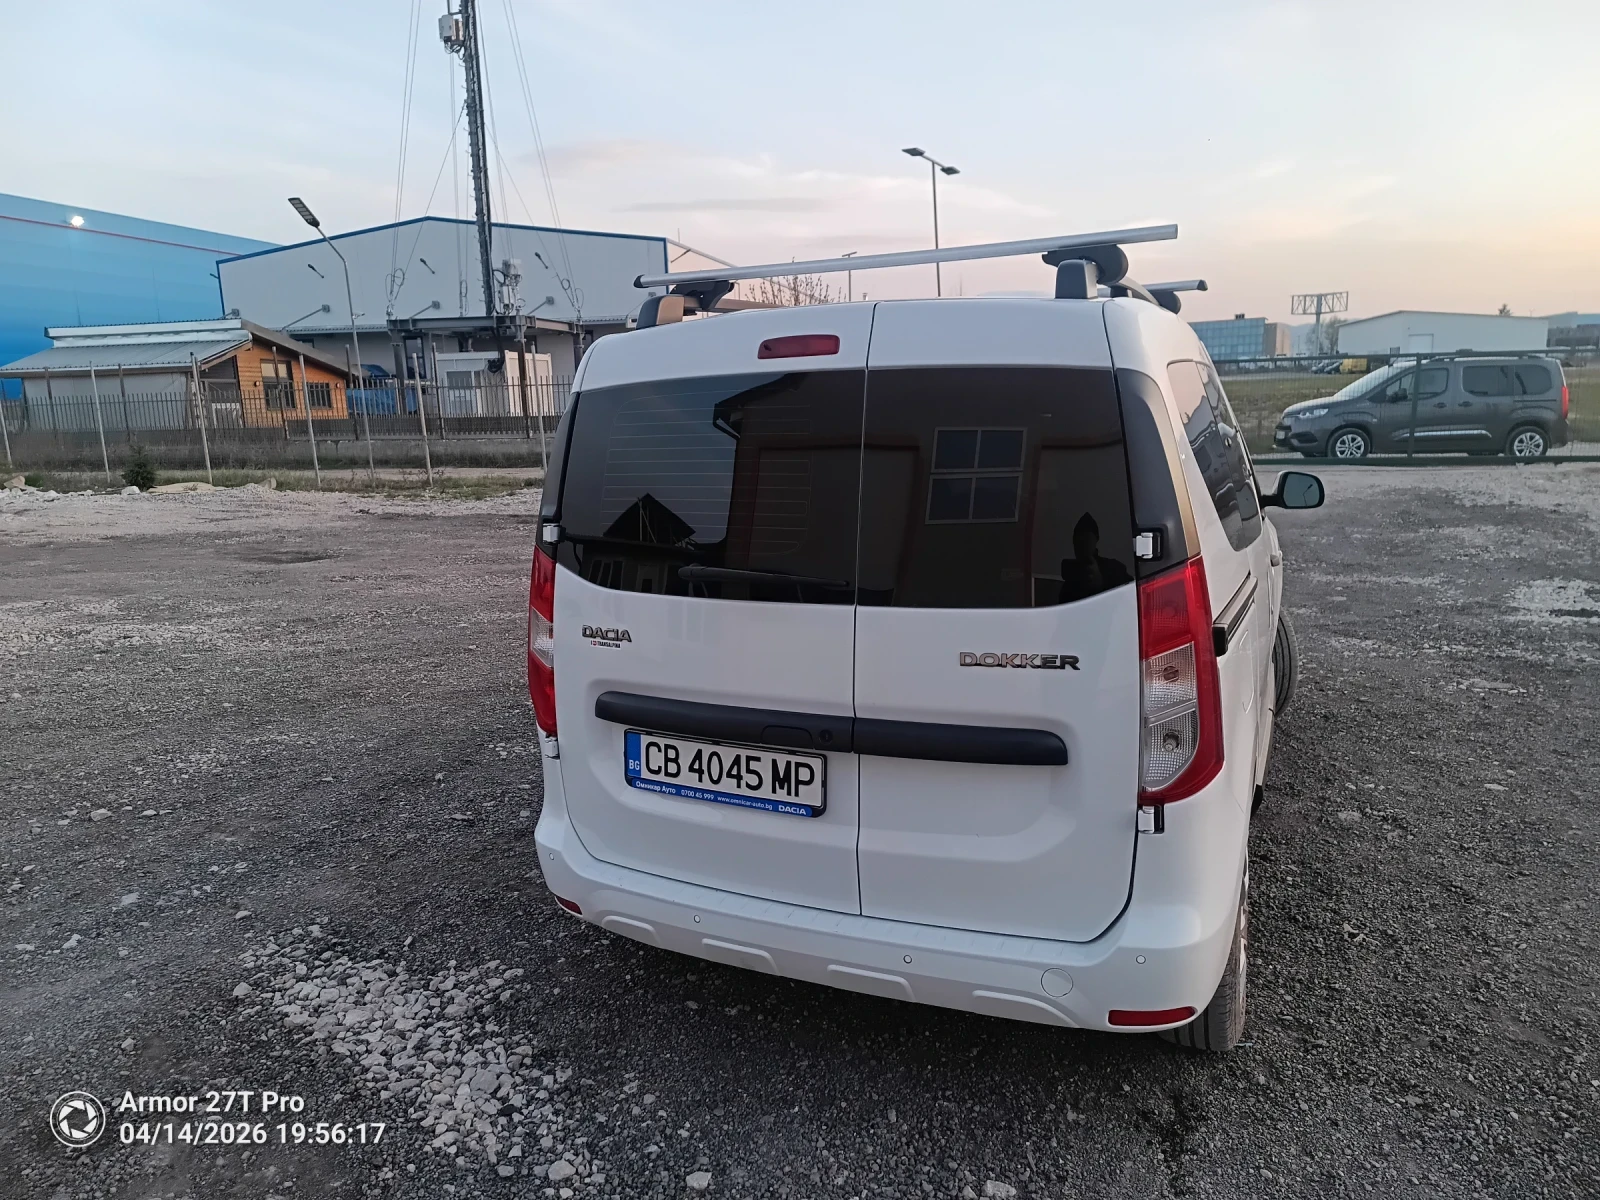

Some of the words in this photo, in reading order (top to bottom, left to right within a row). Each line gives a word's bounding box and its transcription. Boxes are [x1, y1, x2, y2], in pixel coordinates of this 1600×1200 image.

[582, 625, 632, 642] DACIA
[960, 652, 1080, 670] DOKKER
[628, 759, 640, 771] BG
[645, 741, 681, 778] CB
[688, 748, 763, 791] 4045
[771, 758, 815, 797] MP
[635, 780, 661, 792] Омникар
[662, 785, 676, 794] Ауто
[681, 789, 695, 797] 0700
[717, 796, 773, 810] www.omnicar-auto.bg
[778, 804, 806, 815] DACIA
